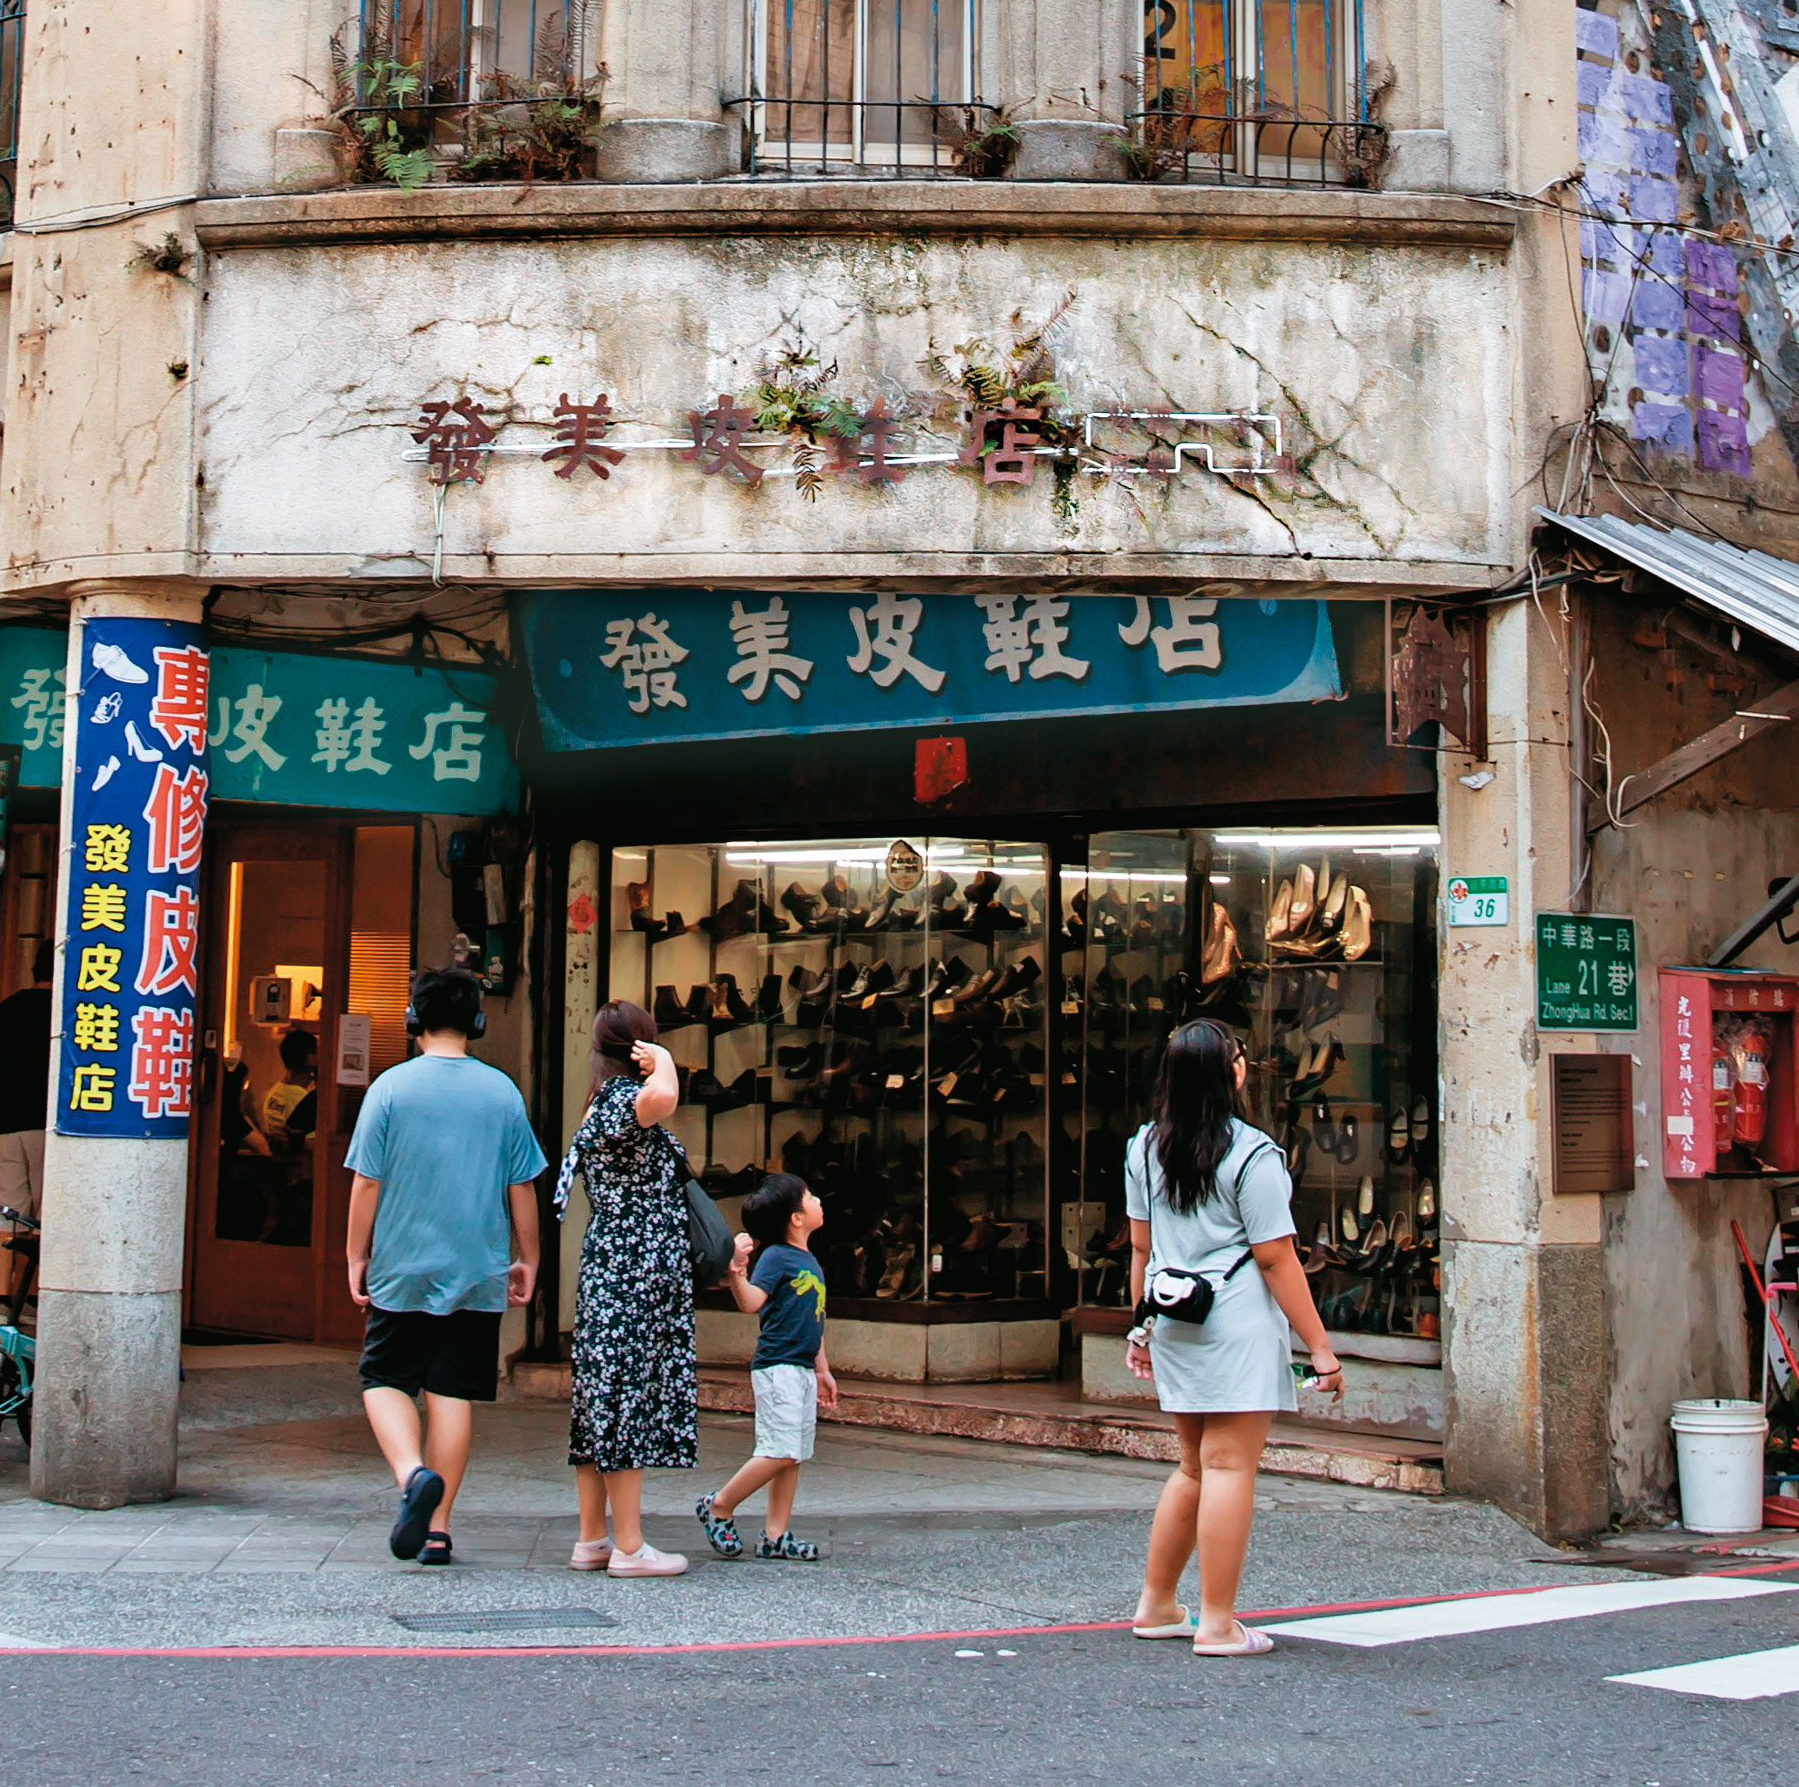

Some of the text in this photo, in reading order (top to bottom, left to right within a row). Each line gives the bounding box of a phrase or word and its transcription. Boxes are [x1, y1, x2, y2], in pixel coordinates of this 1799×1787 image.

[410, 392, 1043, 490] 發美皮鞋店
[600, 593, 1221, 714] 發美皮鞋店
[127, 644, 210, 1119] 專修皮鞋
[1474, 898, 1496, 918] 36
[69, 823, 132, 1112] 發美皮鞋店
[1542, 921, 1631, 952] 中華路一段
[1546, 976, 1571, 994] Lane
[1542, 1002, 1633, 1023] ZhongHua Rd. Sec.1
[1677, 996, 1696, 1173] 光復里辦公公物
